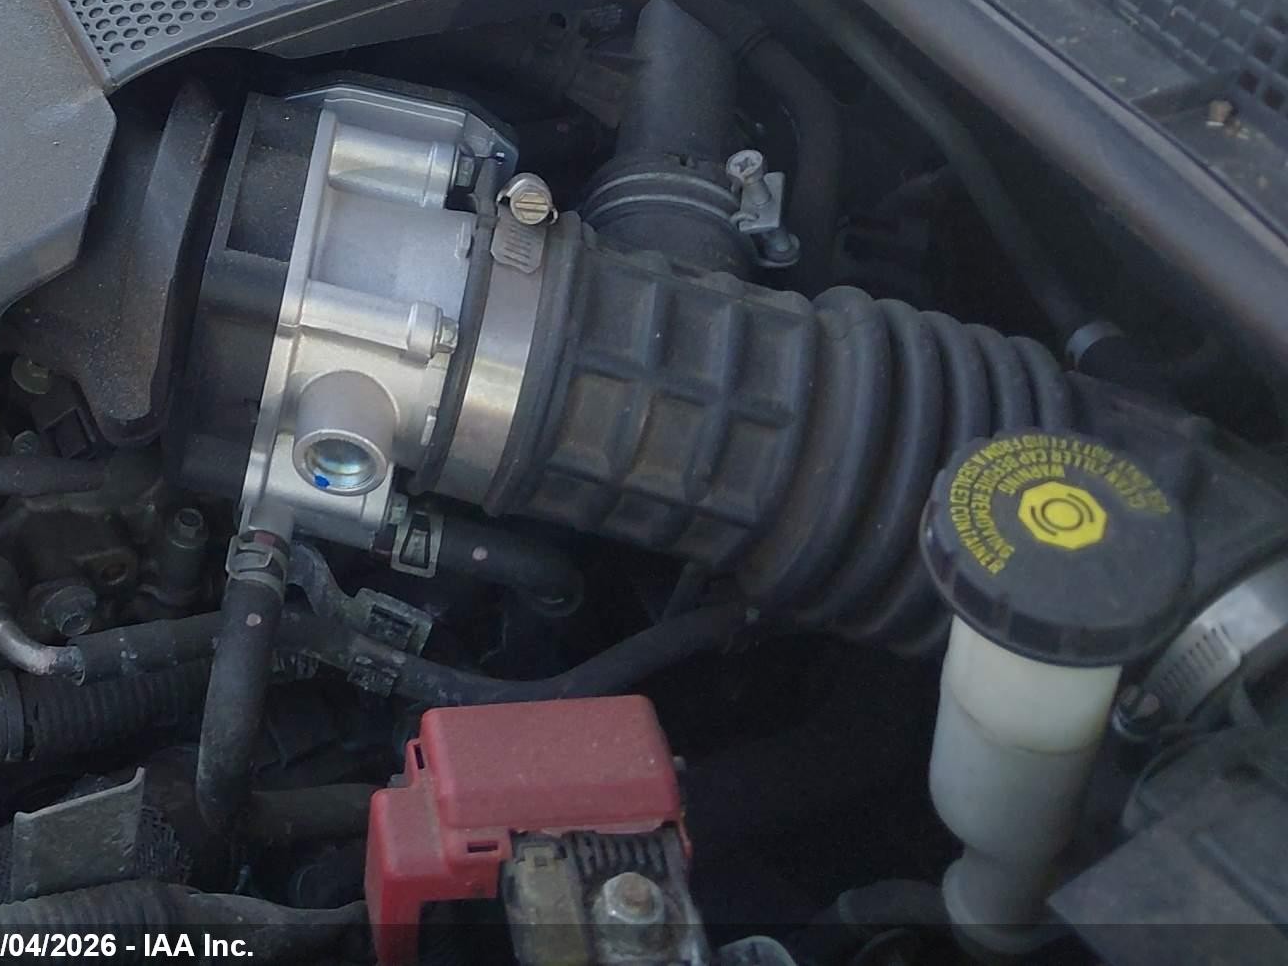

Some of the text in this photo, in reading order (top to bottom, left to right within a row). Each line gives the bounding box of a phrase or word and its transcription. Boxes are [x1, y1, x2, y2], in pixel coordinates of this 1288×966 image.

[979, 437, 1022, 460] FROM
[1018, 448, 1047, 464] CAP
[1021, 434, 1067, 449] FLUID
[973, 454, 1019, 494] BEFORE
[1050, 449, 1106, 475] FILLER
[949, 461, 980, 503] SEALED
[997, 464, 1066, 497] WARNING
[949, 505, 1006, 574] CONTAINER
[971, 493, 1016, 560] REMOVING
